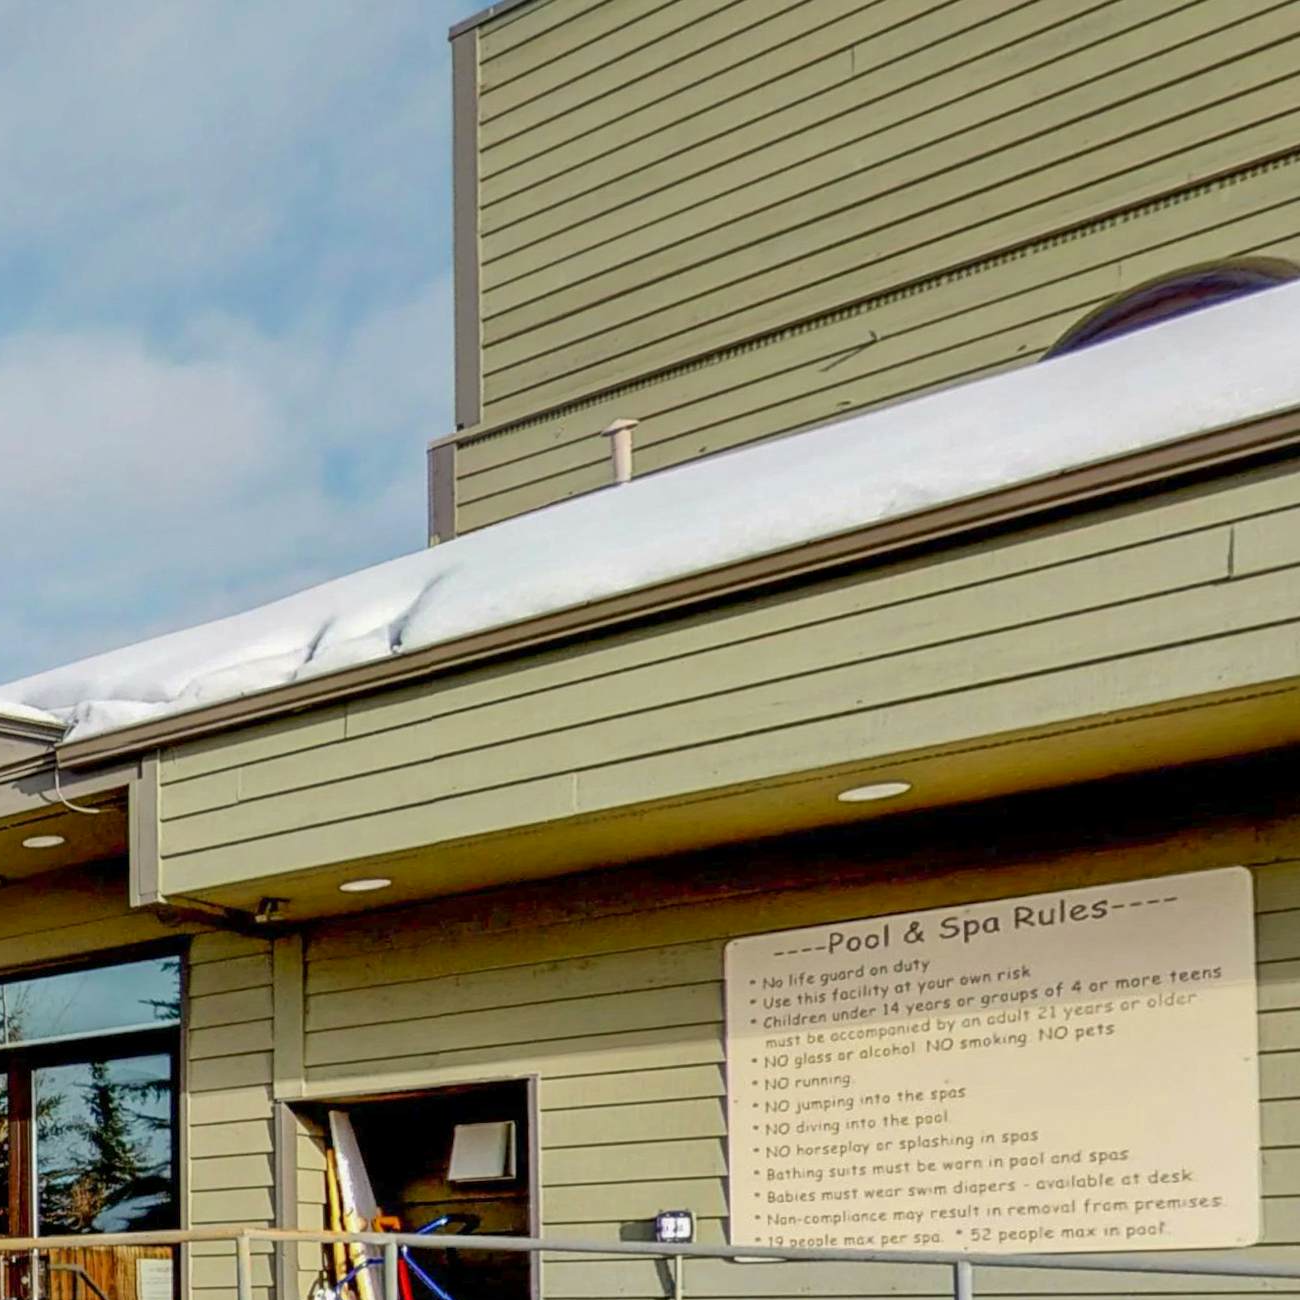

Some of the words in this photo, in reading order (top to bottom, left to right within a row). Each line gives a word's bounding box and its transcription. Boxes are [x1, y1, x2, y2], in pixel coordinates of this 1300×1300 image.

[903, 920, 925, 944] &
[939, 914, 1000, 943] Spa
[762, 976, 783, 990] No
[788, 972, 814, 988] life
[820, 964, 864, 987] guard
[870, 965, 888, 977] on
[893, 958, 931, 974] duty
[763, 996, 791, 1010] Use
[797, 989, 826, 1005] this
[832, 983, 889, 1002] facility
[894, 979, 911, 993] at
[917, 977, 954, 994] your
[960, 972, 992, 986] own
[997, 965, 1031, 982] risk
[763, 1010, 828, 1030] Children
[832, 1003, 876, 1022] under
[883, 1002, 899, 1016] 14
[906, 996, 950, 1016] years
[956, 995, 974, 1008] or
[981, 987, 1038, 1008] groups
[1044, 981, 1064, 997] of
[1071, 980, 1082, 993] 4
[1088, 980, 1109, 993] or
[1115, 974, 1162, 990] more
[1170, 965, 1223, 983] teens
[765, 1036, 801, 1049] must
[807, 1031, 825, 1044] be
[830, 1020, 931, 1043] accompanied
[937, 1017, 956, 1032] by
[961, 1015, 982, 1028] an
[987, 1009, 1030, 1025] adult
[1038, 1005, 1057, 1020] 21
[1063, 1000, 1114, 1020] years
[1120, 998, 1142, 1012] or
[1147, 991, 1198, 1008] older
[764, 1054, 789, 1068] NO
[794, 1052, 832, 1069] glass
[838, 1049, 854, 1062] or
[926, 1038, 954, 1053] NO
[1039, 1025, 1068, 1042] NO
[1075, 1022, 1116, 1042] pets
[764, 1077, 790, 1091] NO
[764, 1099, 790, 1113] NO
[795, 1095, 854, 1115] jumping
[860, 1092, 891, 1106] into
[897, 1089, 924, 1102] the
[930, 1086, 967, 1102] spas
[765, 1122, 790, 1136] NO
[795, 1119, 840, 1135] diving
[845, 1117, 876, 1131] into
[882, 1113, 910, 1127] the
[766, 1145, 791, 1159] NO
[796, 1138, 870, 1160] horseplay
[876, 1140, 893, 1152] or
[899, 1132, 974, 1153] splashing
[980, 1131, 995, 1144] in
[1001, 1128, 1039, 1147] spas
[767, 1167, 824, 1183] Bathing
[829, 1163, 867, 1179] suits
[872, 1161, 910, 1175] must
[916, 1159, 936, 1172] be
[988, 1155, 1004, 1169] in
[1009, 1151, 1044, 1170] pool
[1050, 1149, 1082, 1165] and
[1088, 1147, 1129, 1165] spas
[767, 1190, 816, 1204] Babies
[821, 1188, 858, 1201] must
[864, 1186, 902, 1199] wear
[908, 1184, 948, 1198] swim
[953, 1178, 1016, 1197] diapers
[1036, 1172, 1116, 1191] available
[1121, 1172, 1140, 1187] at
[767, 1209, 888, 1227] Non-compliance
[893, 1208, 924, 1224] may
[930, 1204, 980, 1220] result
[987, 1203, 1002, 1218] in
[1007, 1199, 1076, 1217] removal
[1083, 1198, 1129, 1214] from
[768, 1235, 784, 1248] 19
[789, 1232, 838, 1249] people
[844, 1234, 875, 1247] max
[881, 1232, 908, 1247] per
[971, 1227, 993, 1242] 52
[998, 1225, 1055, 1244] people
[1061, 1226, 1097, 1240] max
[1104, 1225, 1121, 1238] in
